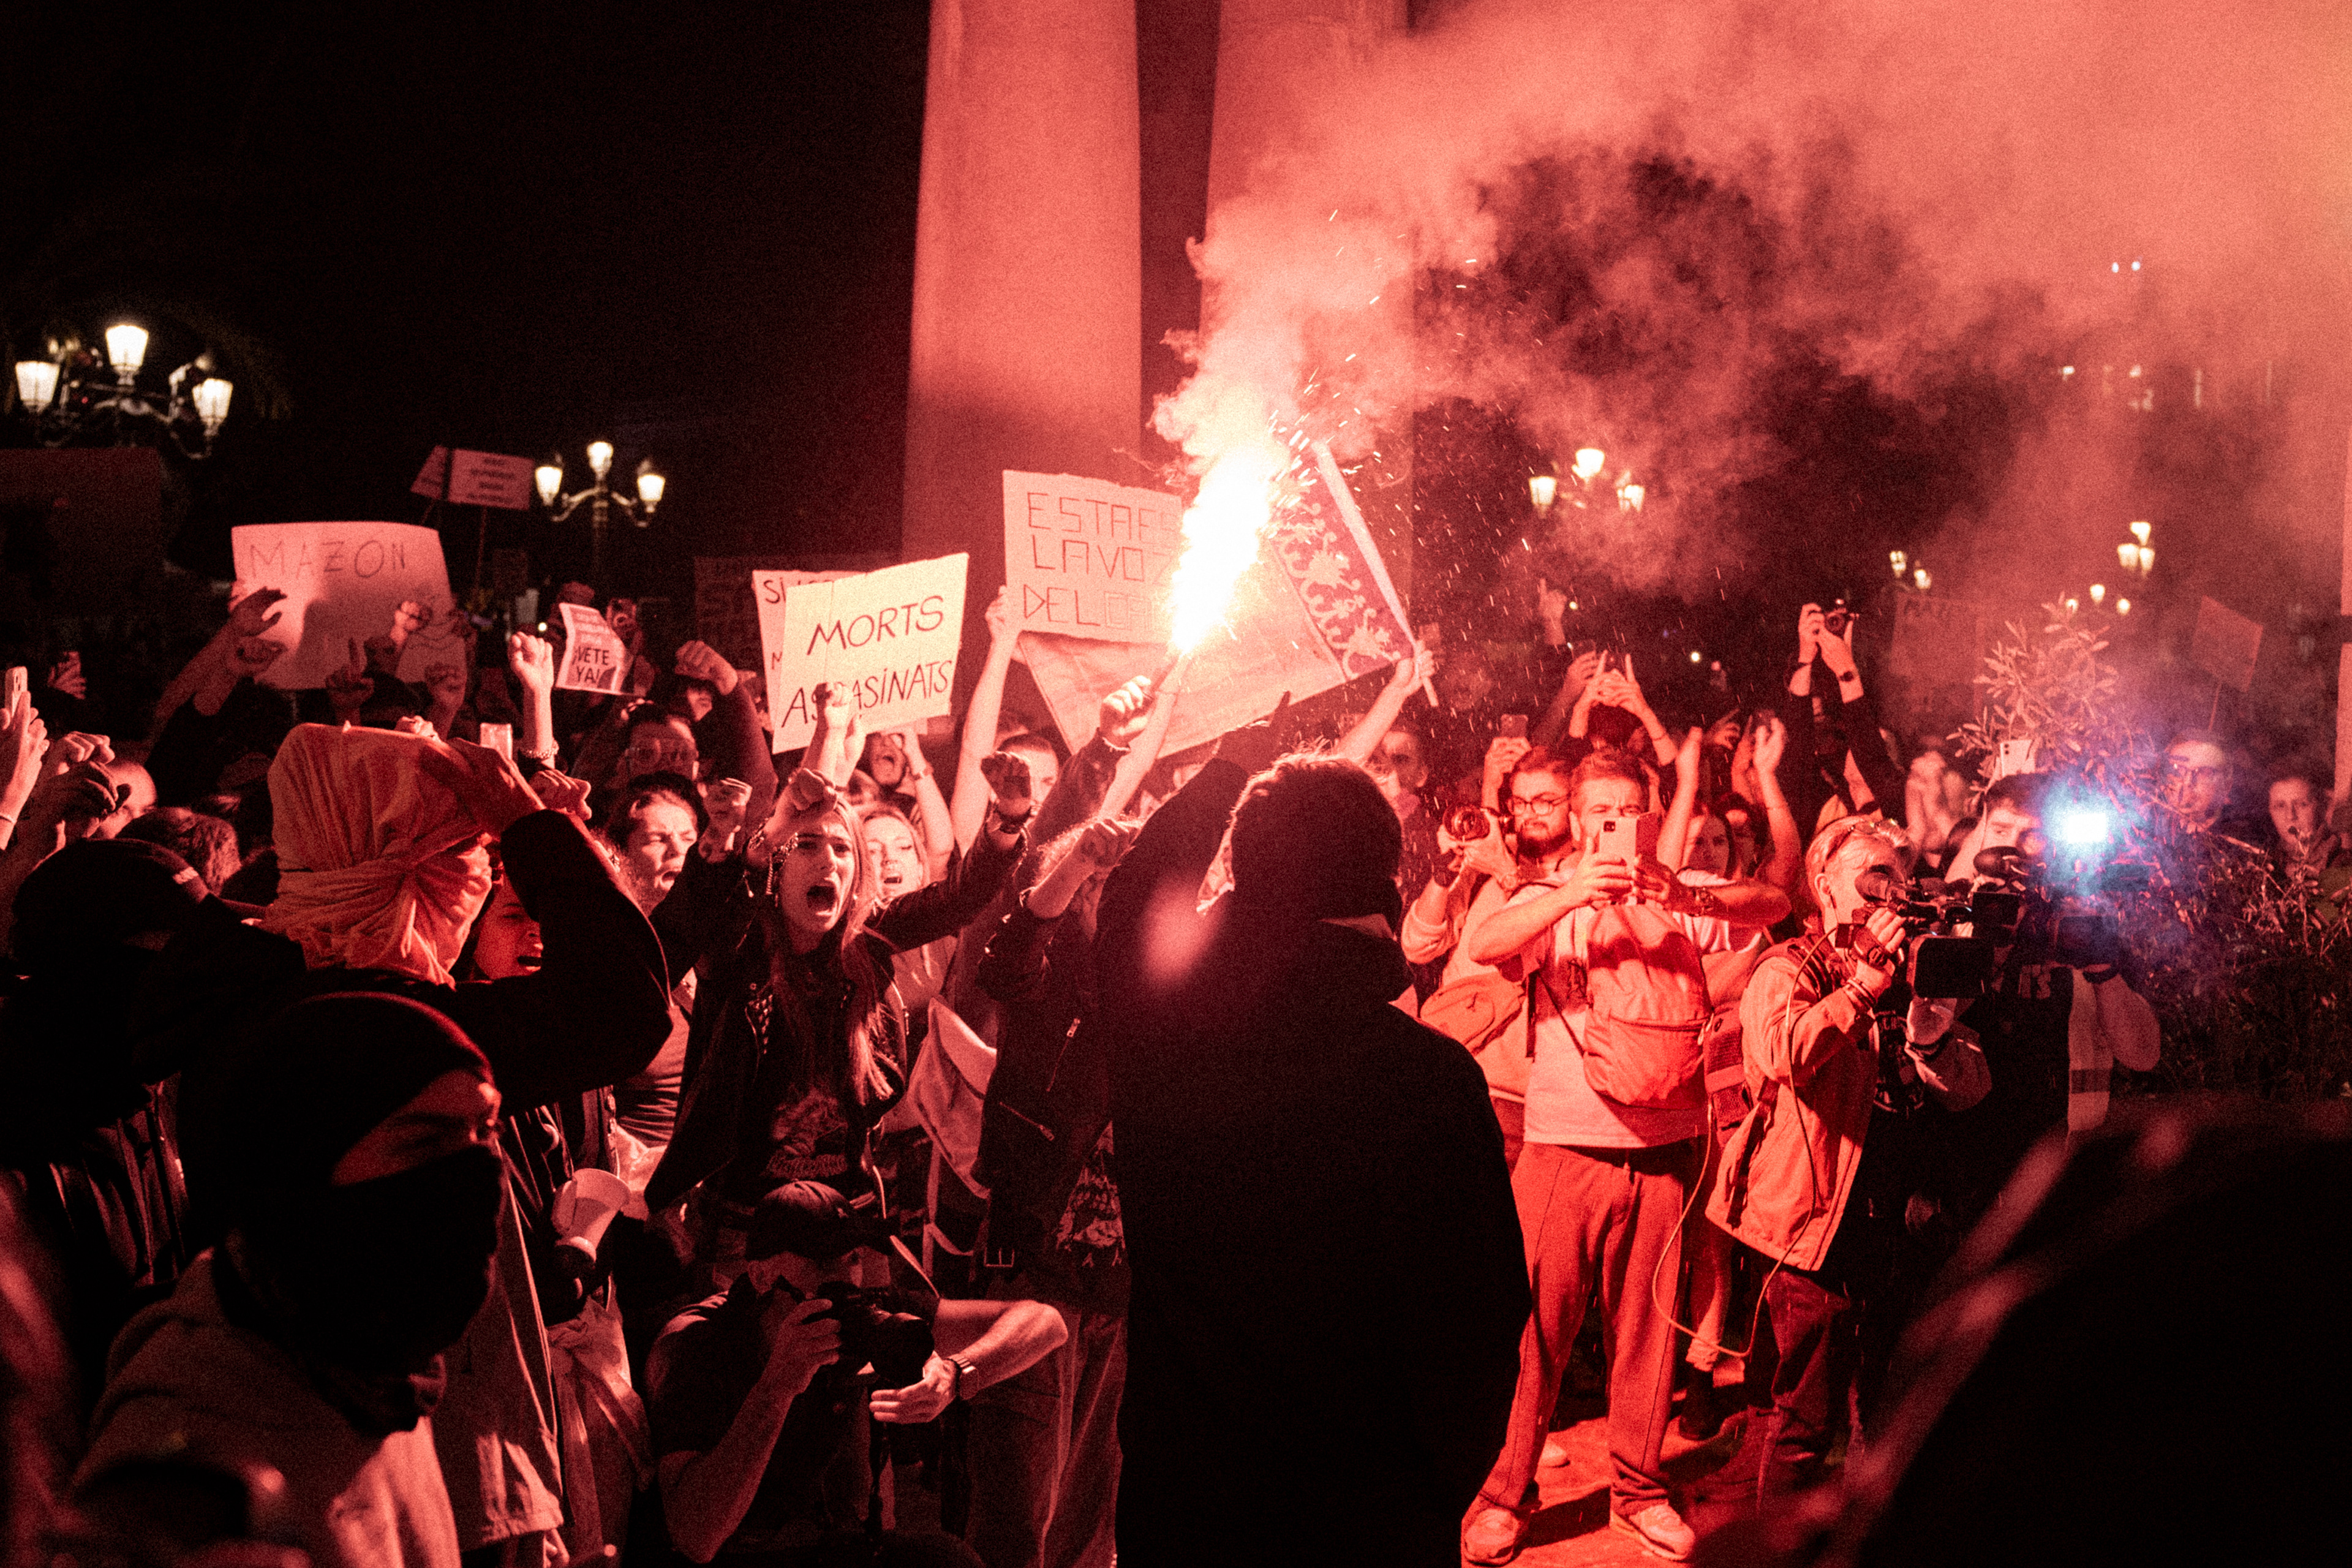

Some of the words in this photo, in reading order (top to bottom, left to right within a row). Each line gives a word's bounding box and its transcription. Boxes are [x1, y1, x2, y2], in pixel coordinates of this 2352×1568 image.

[1027, 492, 1131, 540] ESTA
[1032, 534, 1089, 575] LA
[807, 595, 944, 656] MORTS
[1023, 584, 1101, 626] DEL
[782, 660, 952, 728] AASINATS
